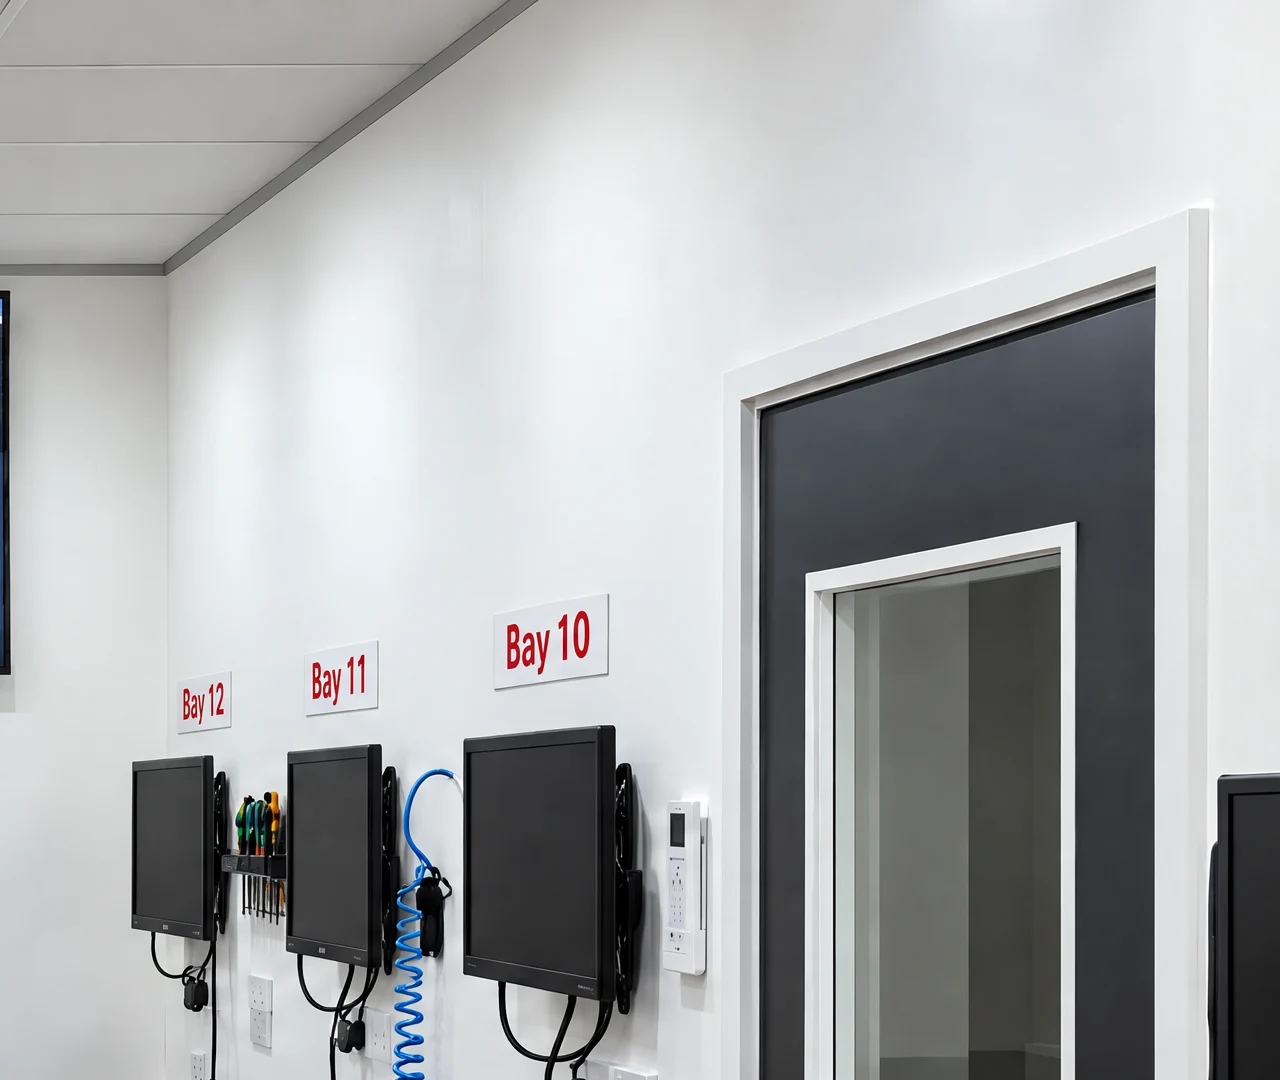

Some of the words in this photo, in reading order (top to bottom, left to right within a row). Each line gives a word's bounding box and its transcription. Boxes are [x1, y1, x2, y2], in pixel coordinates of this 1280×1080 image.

[506, 623, 551, 675] Bay
[557, 609, 591, 661] 10
[182, 687, 205, 725] Bay
[208, 681, 225, 716] 12
[311, 661, 342, 706] Bay
[347, 654, 366, 695] 11
